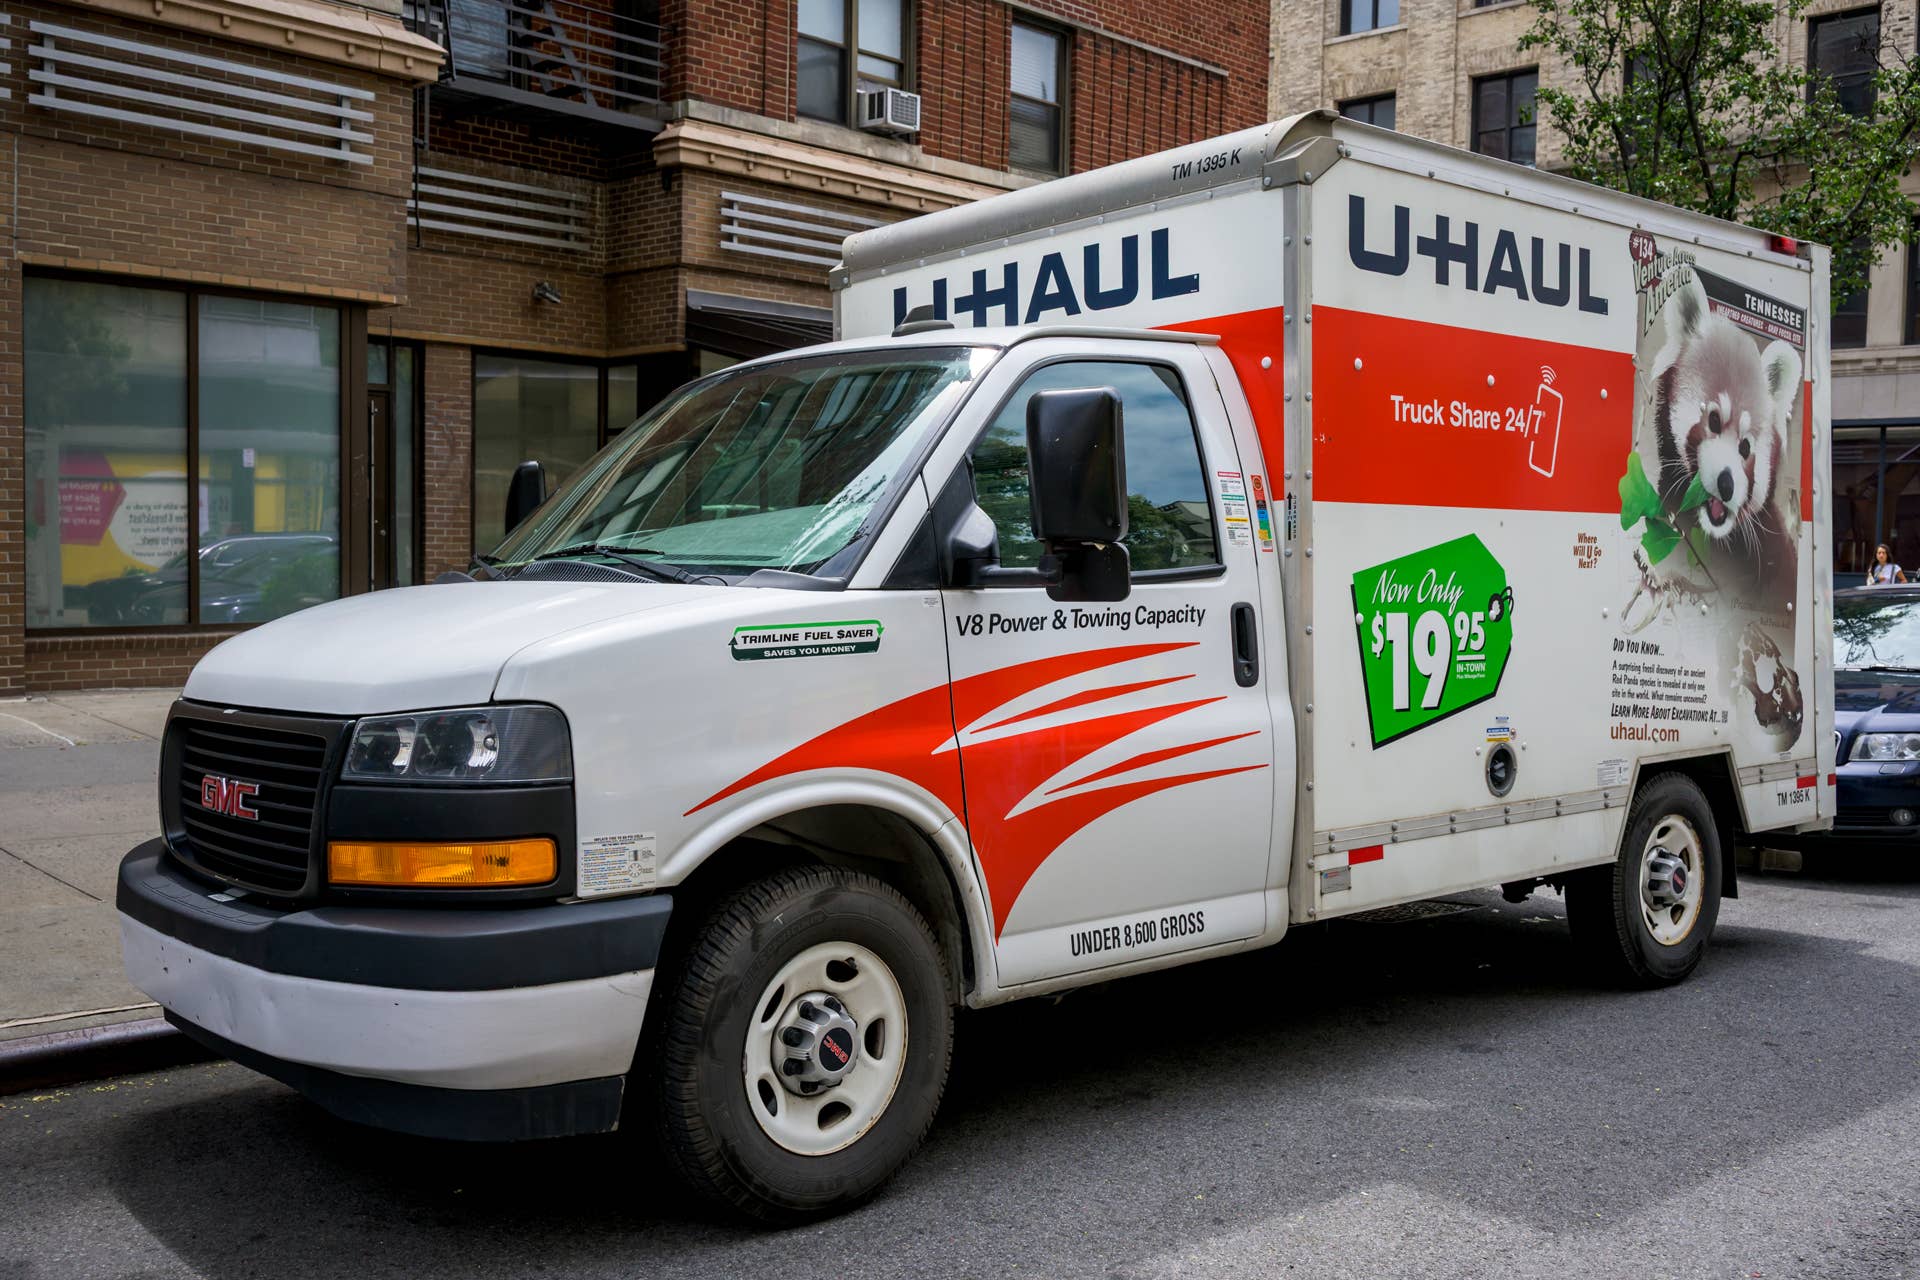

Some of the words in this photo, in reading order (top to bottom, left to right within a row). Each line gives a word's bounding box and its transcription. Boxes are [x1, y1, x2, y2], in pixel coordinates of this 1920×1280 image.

[1172, 161, 1193, 181] TM
[1196, 152, 1228, 174] 1395
[1230, 148, 1242, 166] K
[1349, 194, 1608, 316] U-HAUL
[1632, 236, 1653, 261] #134
[1633, 253, 1671, 294] Venture
[1672, 246, 1696, 267] Across
[1643, 268, 1692, 337] America
[1744, 293, 1802, 328] TENNESSEE
[1390, 394, 1445, 426] Truck
[1449, 400, 1500, 431] Share
[1505, 404, 1543, 438] 24/7
[1577, 532, 1598, 544] Where
[1573, 545, 1586, 556] Will
[1587, 545, 1593, 559] U
[1594, 546, 1602, 557] Go
[1578, 557, 1598, 569] Next?
[1371, 568, 1414, 604] Now
[1417, 567, 1465, 617] Only
[956, 613, 984, 636] V8
[988, 613, 1047, 634] Power
[1052, 609, 1067, 630] &
[1070, 607, 1131, 631] Towing
[1134, 604, 1206, 629] Capacity
[741, 633, 800, 645] TRIMLINE
[804, 631, 834, 641] FUEL
[837, 629, 873, 640] $AVER
[764, 648, 797, 658] SAVES
[799, 647, 820, 655] YOU
[822, 645, 856, 654] MONEY
[1612, 659, 1617, 671] A
[1456, 662, 1487, 673] IN-TOWN
[1612, 673, 1622, 684] Red
[1623, 674, 1639, 685] Panda
[1610, 721, 1680, 741] uhaul.com
[201, 774, 260, 821] GMC
[1777, 791, 1788, 807] TM
[1789, 789, 1804, 805] 1395
[1804, 788, 1811, 802] K
[1070, 926, 1121, 956] UNDER
[1124, 920, 1157, 948] 8,600
[1160, 911, 1205, 940] GROSS
[823, 1035, 849, 1064] GMC
